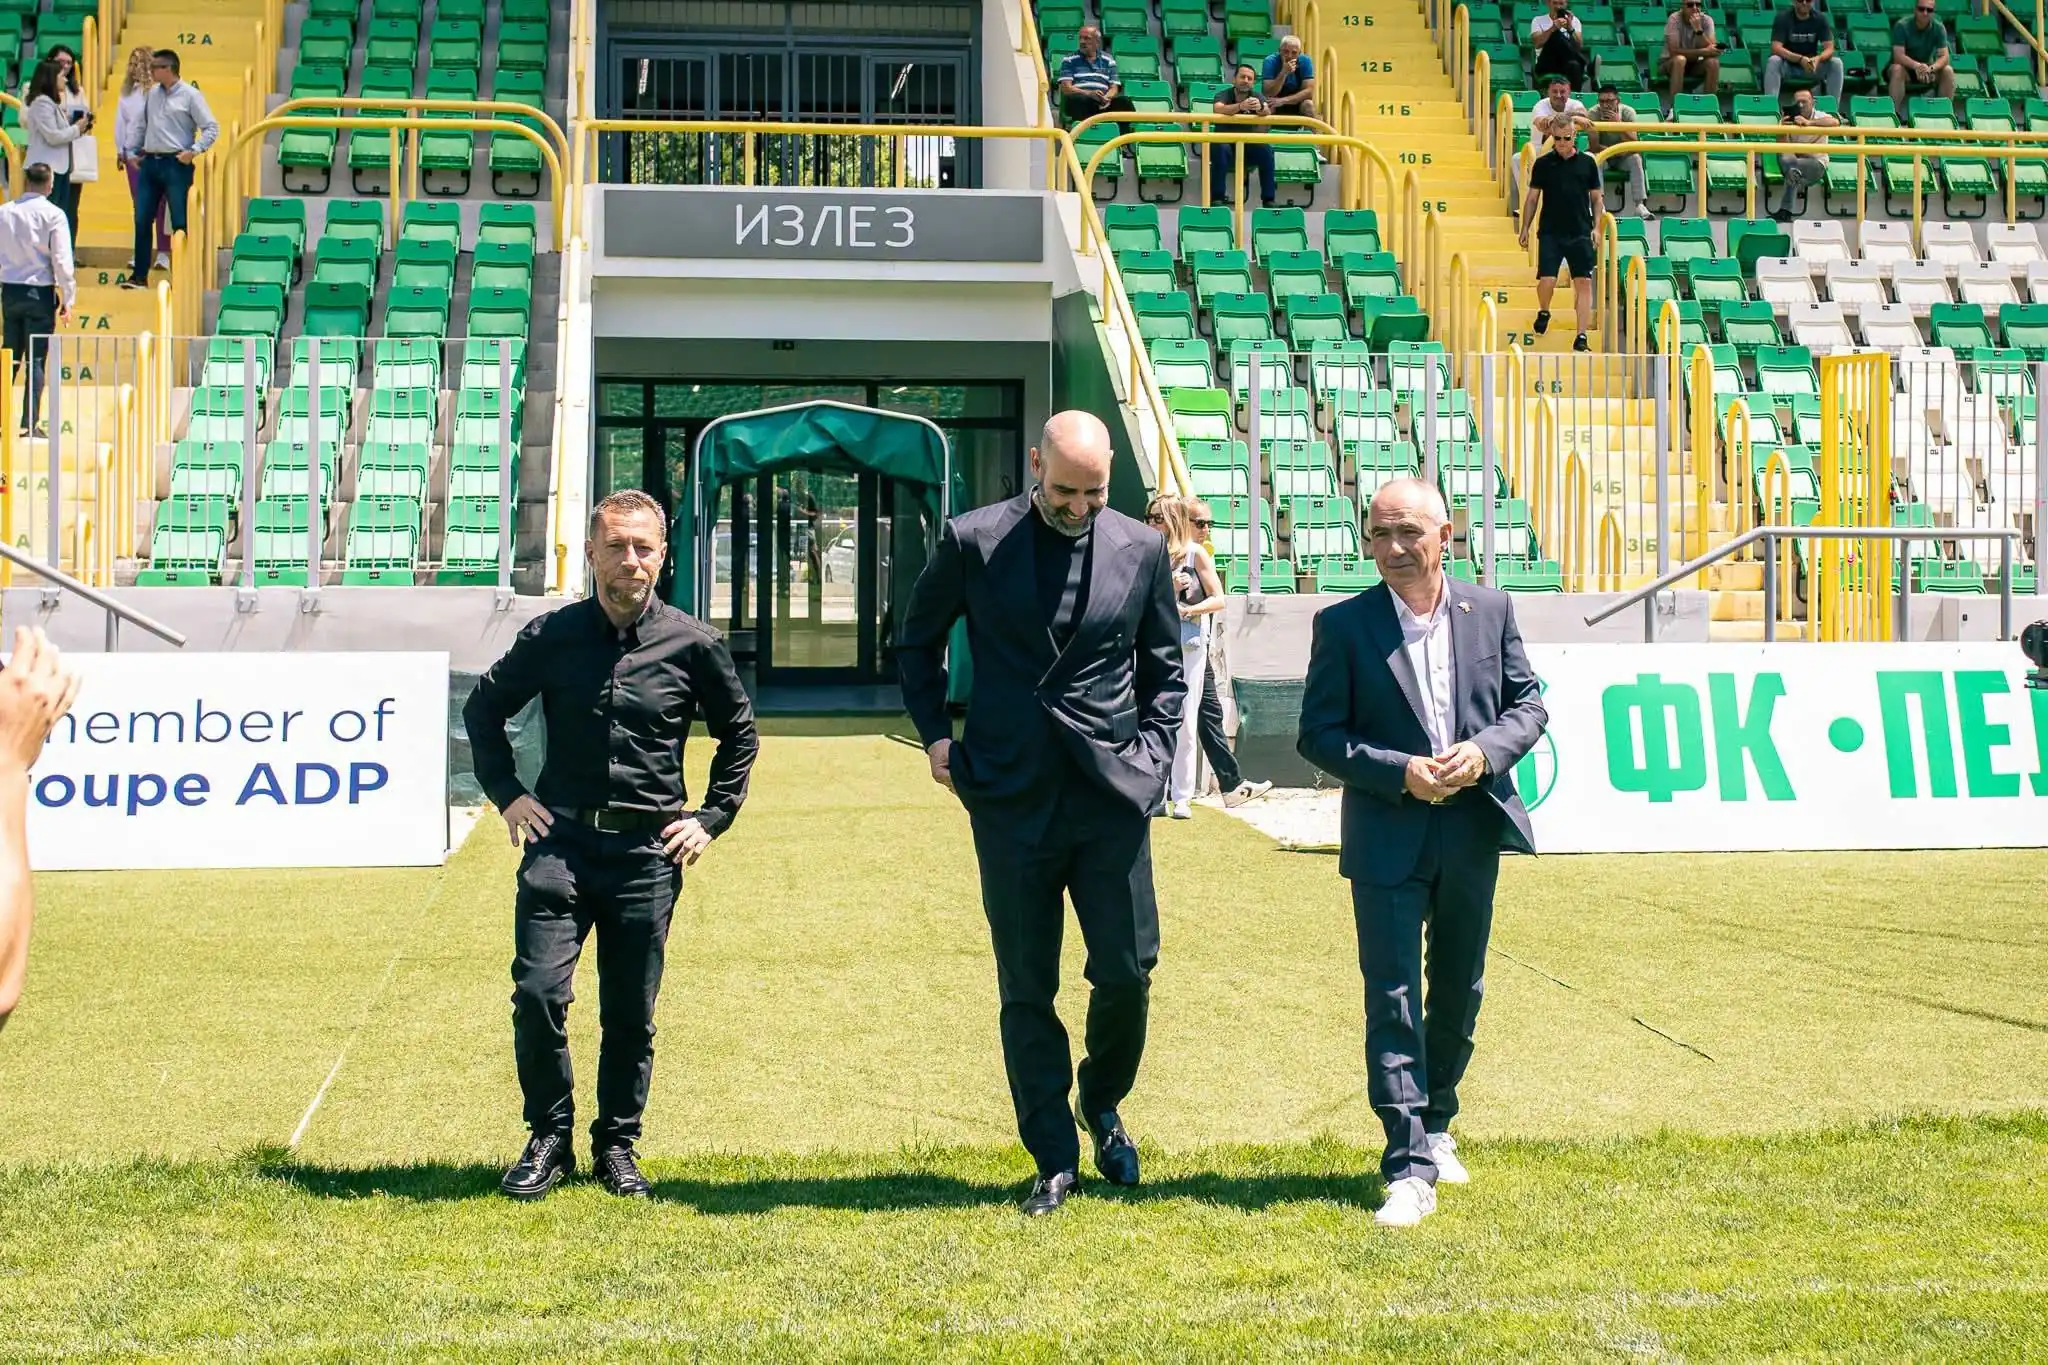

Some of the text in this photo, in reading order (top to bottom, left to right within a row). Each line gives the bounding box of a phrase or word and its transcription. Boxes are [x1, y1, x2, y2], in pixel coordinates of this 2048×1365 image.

[1343, 15, 1374, 26] 13 Б
[177, 33, 196, 45] 12
[1361, 61, 1393, 73] 12 Б
[1379, 104, 1411, 116] 11 Б
[1399, 153, 1432, 164] 10 Б
[1422, 201, 1447, 212] 9 Б
[735, 203, 914, 248] ИЗЛЕЗ
[98, 272, 108, 285] 8
[1497, 291, 1508, 304] Б
[79, 315, 90, 329] 7
[1507, 333, 1535, 346] 7 Б
[61, 366, 72, 380] 6
[1534, 380, 1545, 393] 6
[1564, 430, 1574, 443] 5
[17, 476, 28, 490] 4
[1593, 480, 1603, 494] 4
[1627, 538, 1638, 552] 3
[329, 697, 396, 743] of
[1601, 669, 2048, 803] ФК ПЕ
[28, 762, 389, 817] oupe ADP
